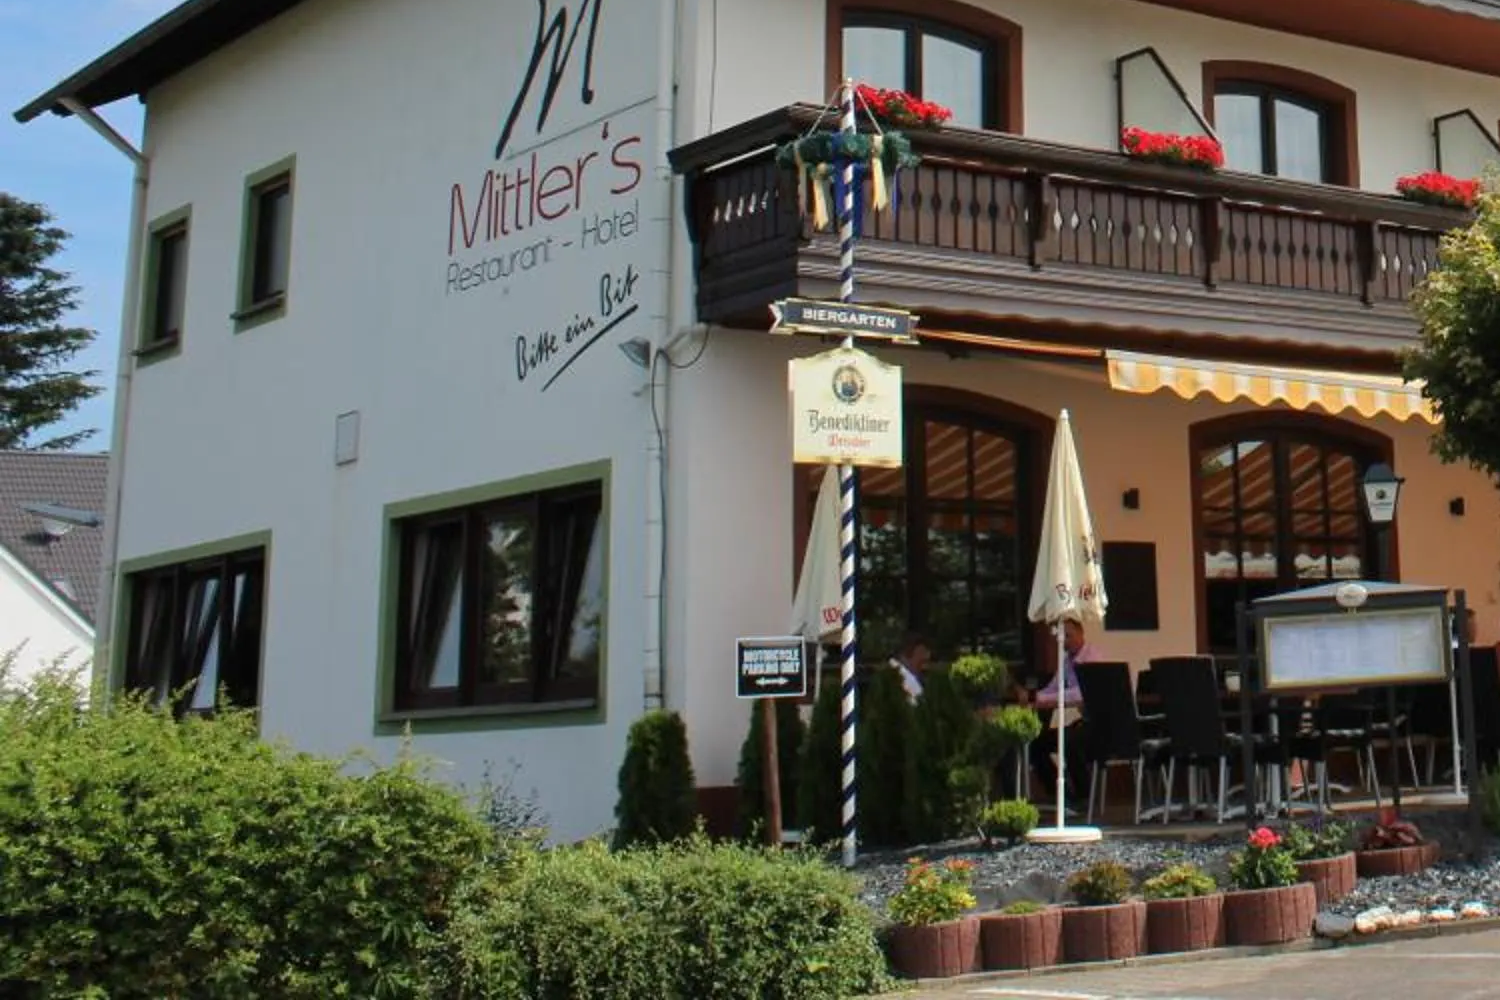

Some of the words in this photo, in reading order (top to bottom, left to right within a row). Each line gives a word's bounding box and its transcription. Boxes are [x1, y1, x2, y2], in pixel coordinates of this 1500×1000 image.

[448, 122, 641, 257] Mittler's
[446, 236, 553, 297] Restaurant
[581, 198, 640, 249] Hotel
[516, 331, 559, 381] Bitte
[565, 313, 595, 343] ein
[600, 263, 640, 317] Bit
[802, 308, 897, 329] BIERGARTEN
